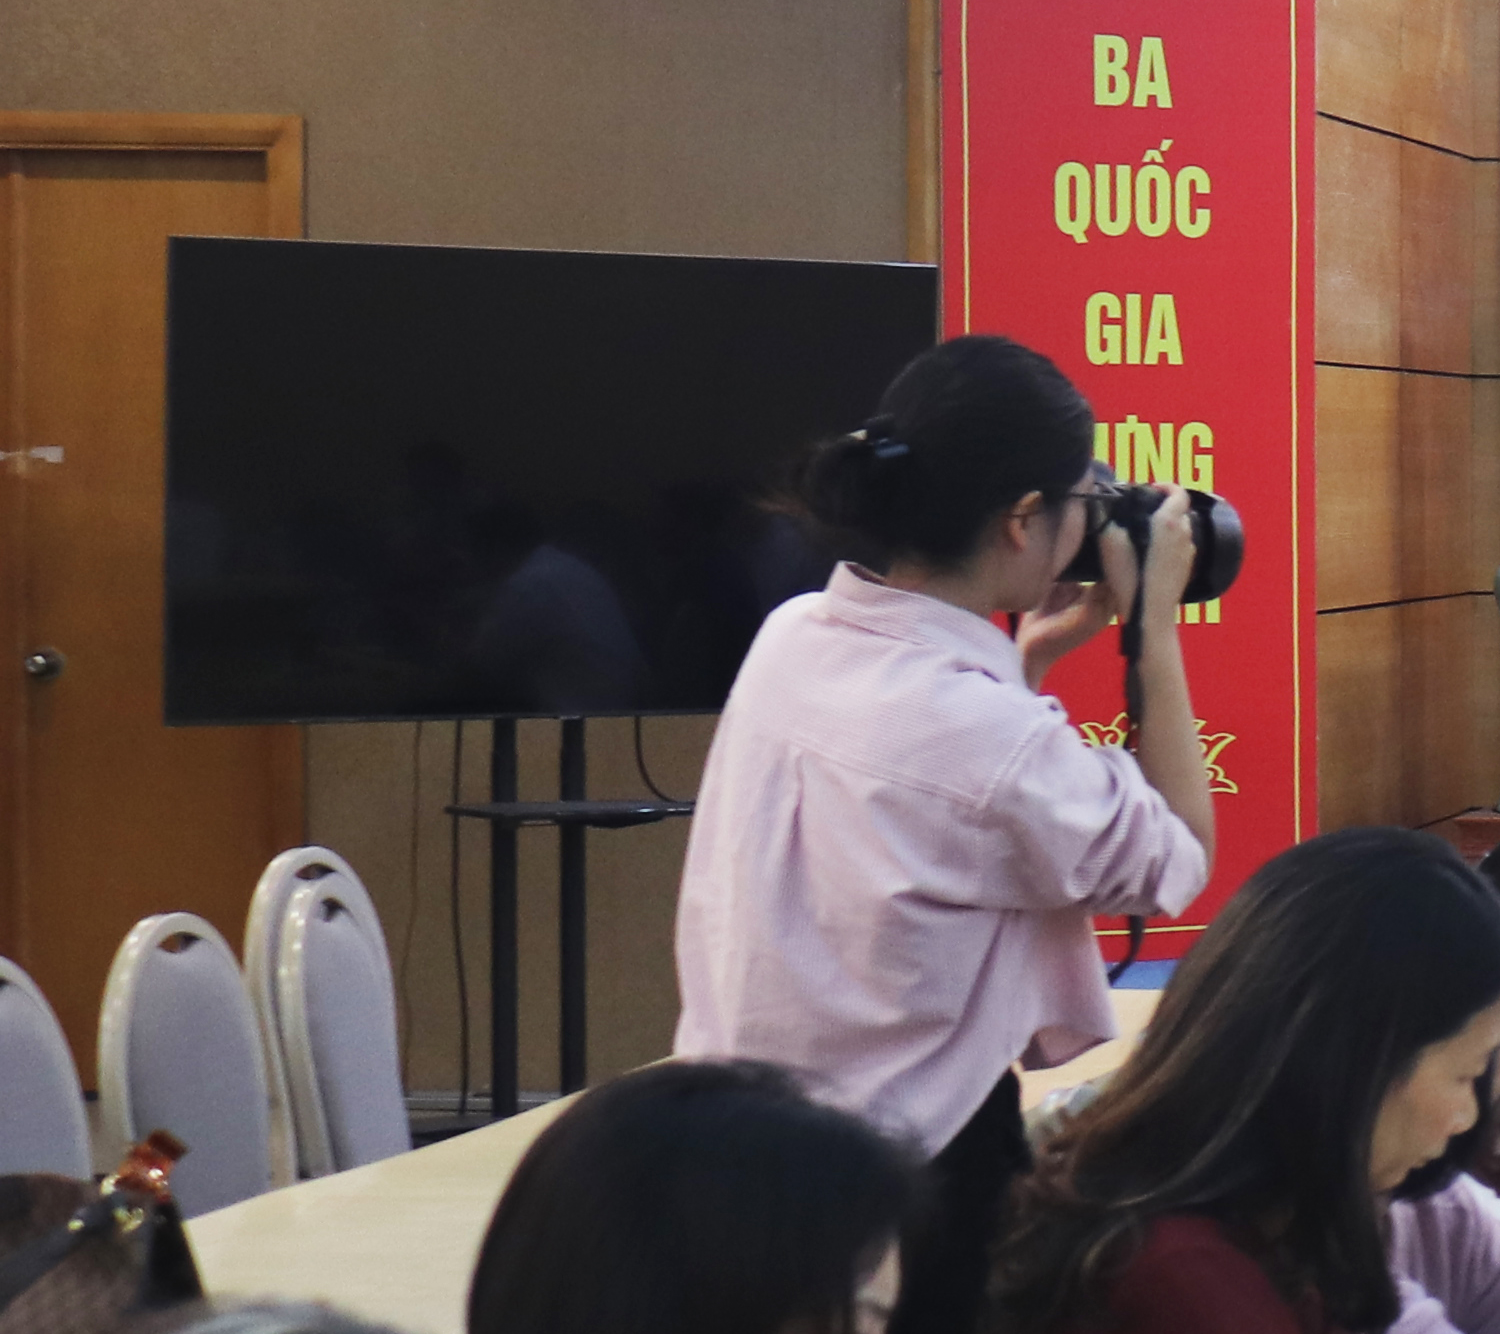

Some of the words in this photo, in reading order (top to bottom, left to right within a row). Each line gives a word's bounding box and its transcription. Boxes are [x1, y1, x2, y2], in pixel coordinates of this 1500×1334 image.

[1092, 34, 1173, 110] BA
[1053, 139, 1212, 244] QUỐC
[1084, 291, 1184, 367] GIA
